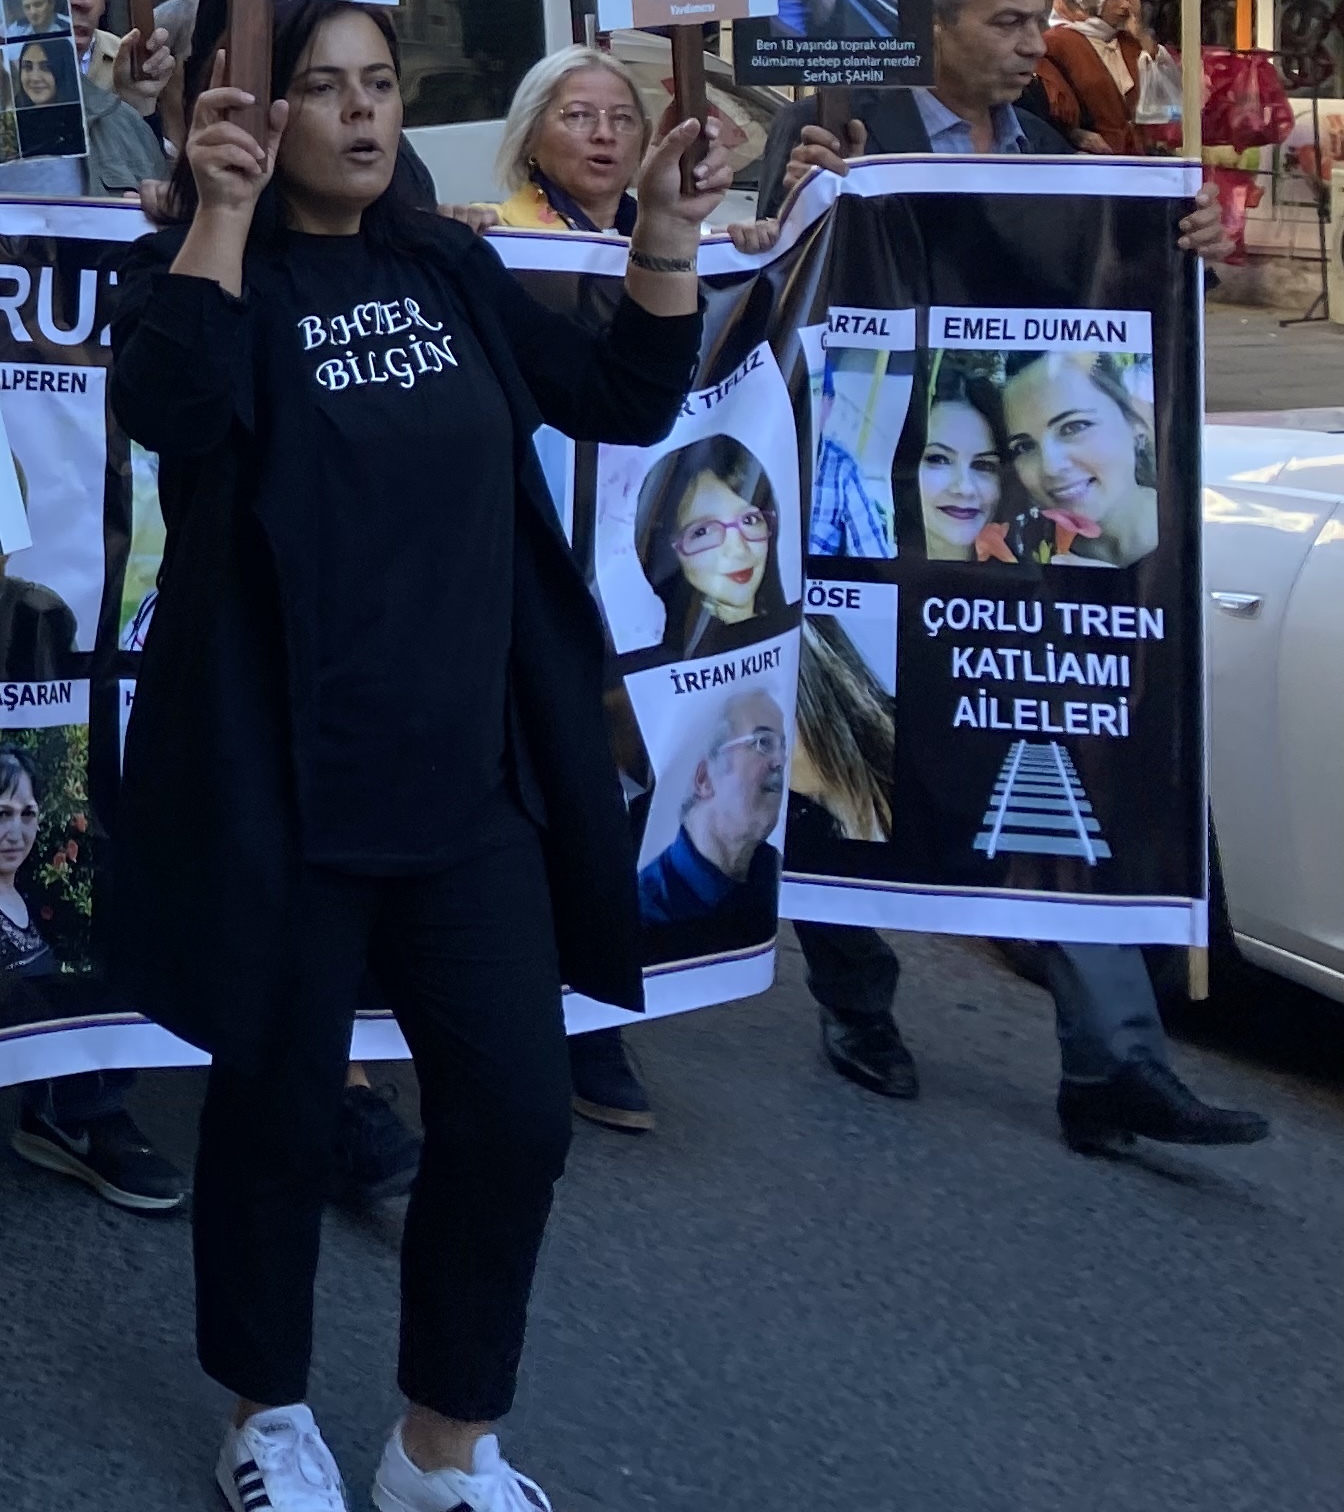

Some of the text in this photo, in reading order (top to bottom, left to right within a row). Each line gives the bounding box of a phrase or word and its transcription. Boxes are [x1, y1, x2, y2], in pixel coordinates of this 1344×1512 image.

[751, 55, 922, 69] ölümüme sebep olanlar nerde?
[756, 39, 915, 54] Ben 18 yaşında toprak oldum
[803, 69, 884, 85] Serhat ŞAHİN
[943, 317, 1129, 345] EMEL DUMAN
[315, 334, 459, 391] BİLGİN
[922, 596, 1165, 640] ÇORLU TREN
[670, 645, 782, 695] İRFAN KURT
[951, 640, 1132, 688] KATLİAMI
[952, 690, 1131, 737] AİLELERİ
